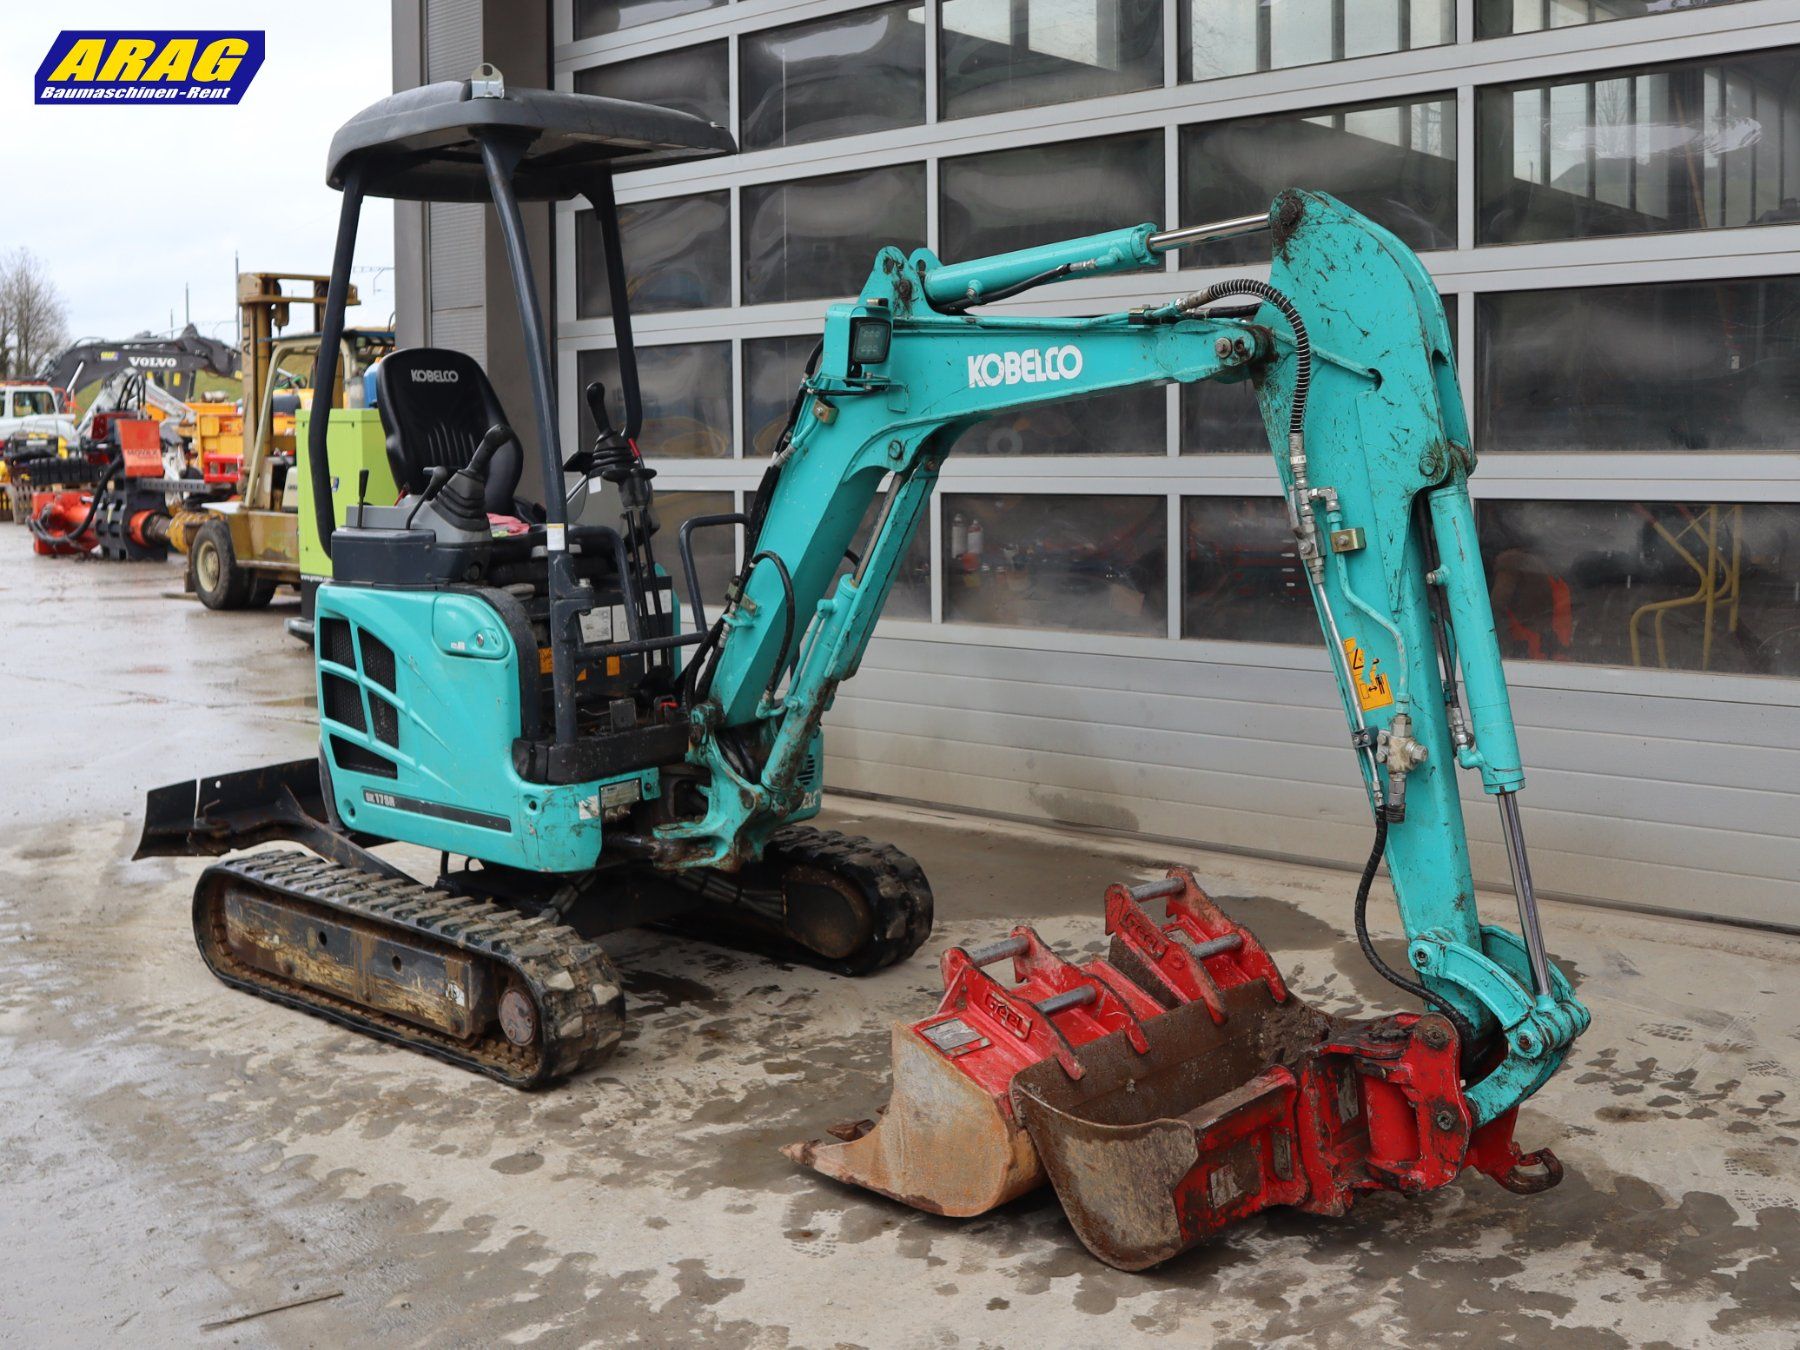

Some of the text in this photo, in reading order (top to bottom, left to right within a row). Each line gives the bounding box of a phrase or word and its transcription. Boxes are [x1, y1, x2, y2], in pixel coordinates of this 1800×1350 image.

[128, 356, 177, 368] VOLVO
[966, 344, 1083, 388] KOBELCO
[410, 369, 459, 382] KOBELCO
